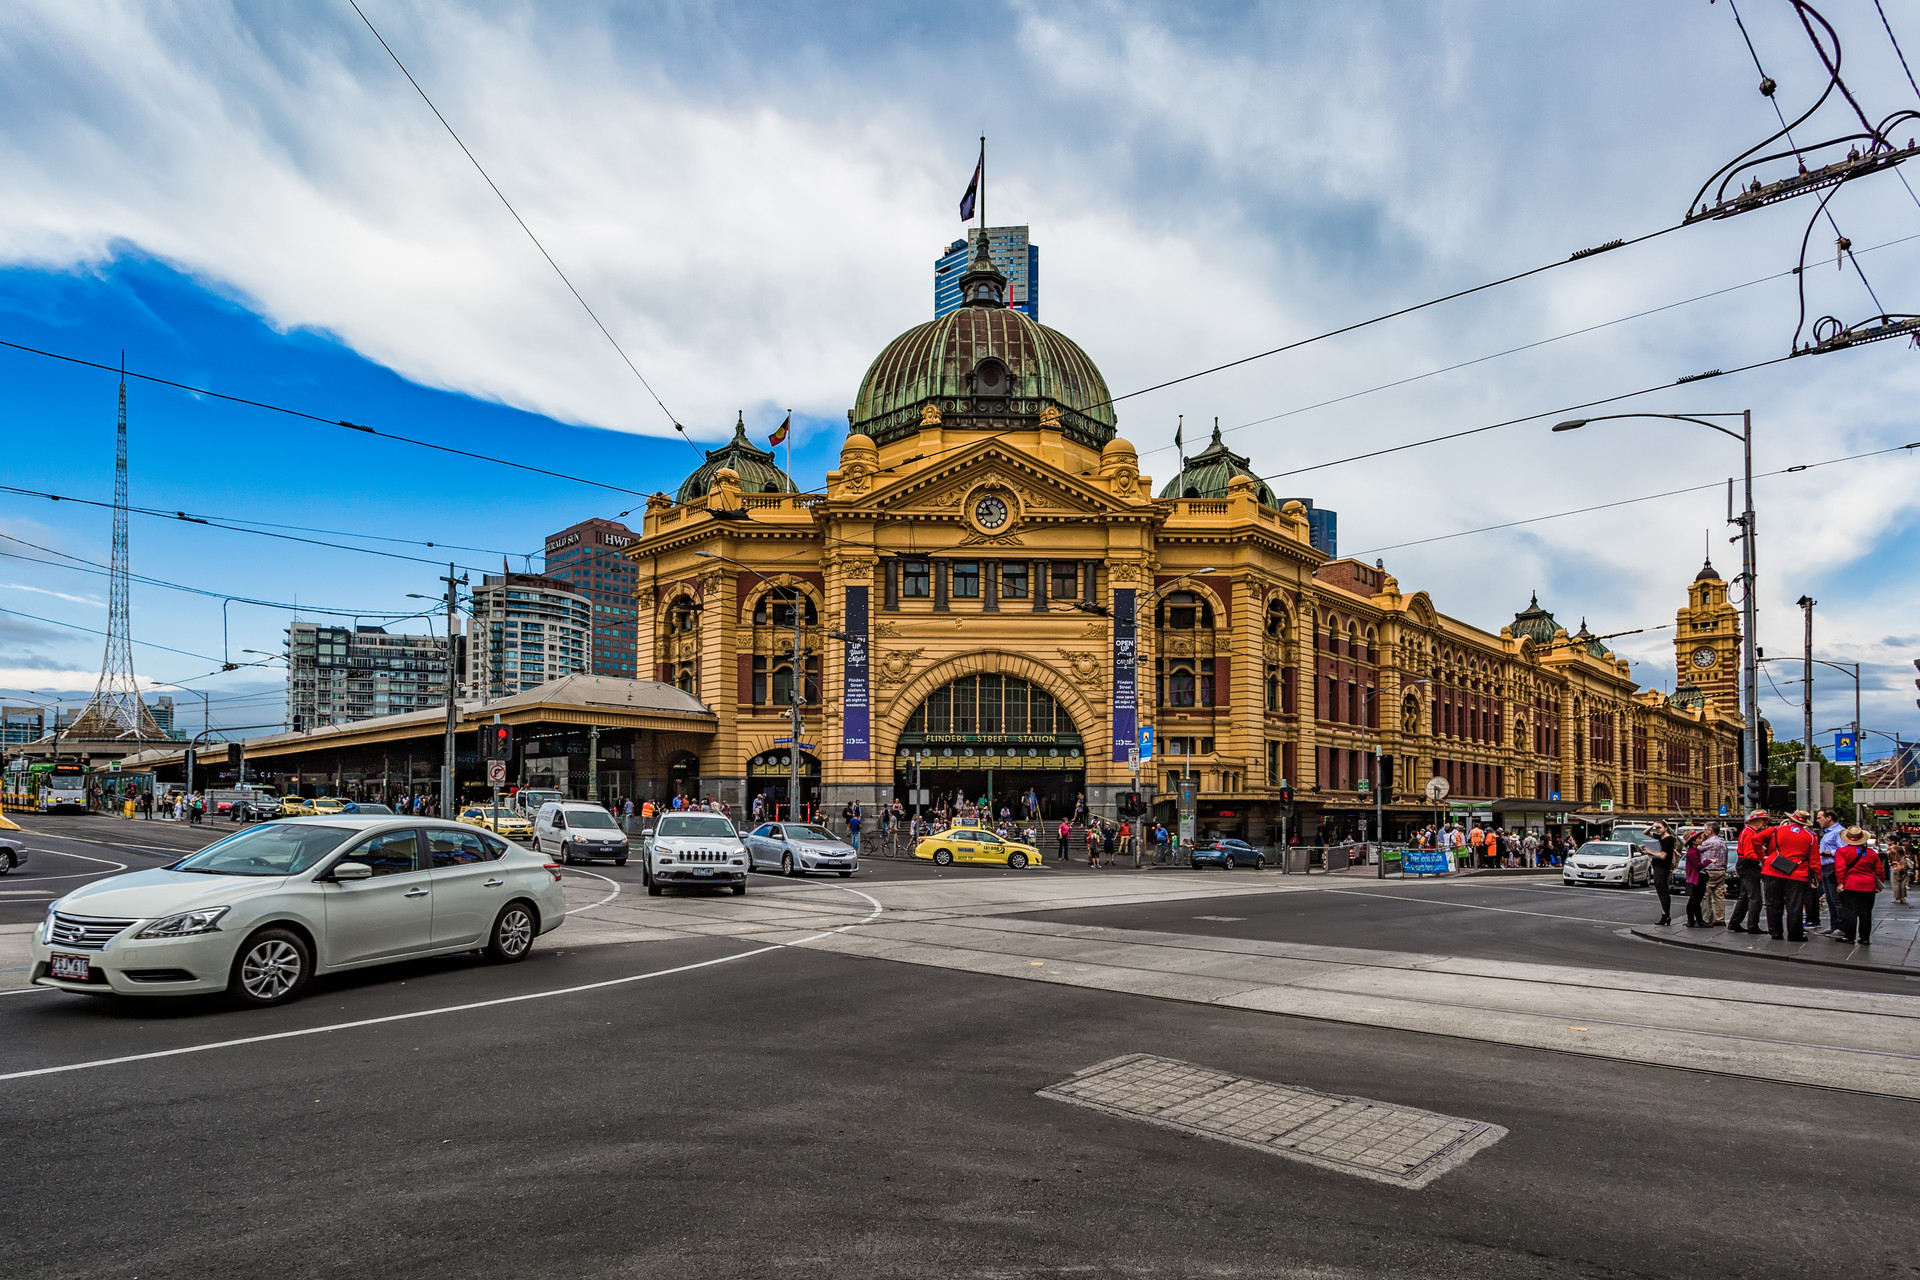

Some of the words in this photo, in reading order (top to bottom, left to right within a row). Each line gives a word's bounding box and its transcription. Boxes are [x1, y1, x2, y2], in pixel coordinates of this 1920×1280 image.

[567, 533, 580, 544] SUN
[605, 534, 631, 546] HWT
[926, 735, 967, 743] FLINDERS
[977, 735, 1009, 743] STREET
[1018, 735, 1056, 743] STATION
[52, 957, 68, 970] ZSJ
